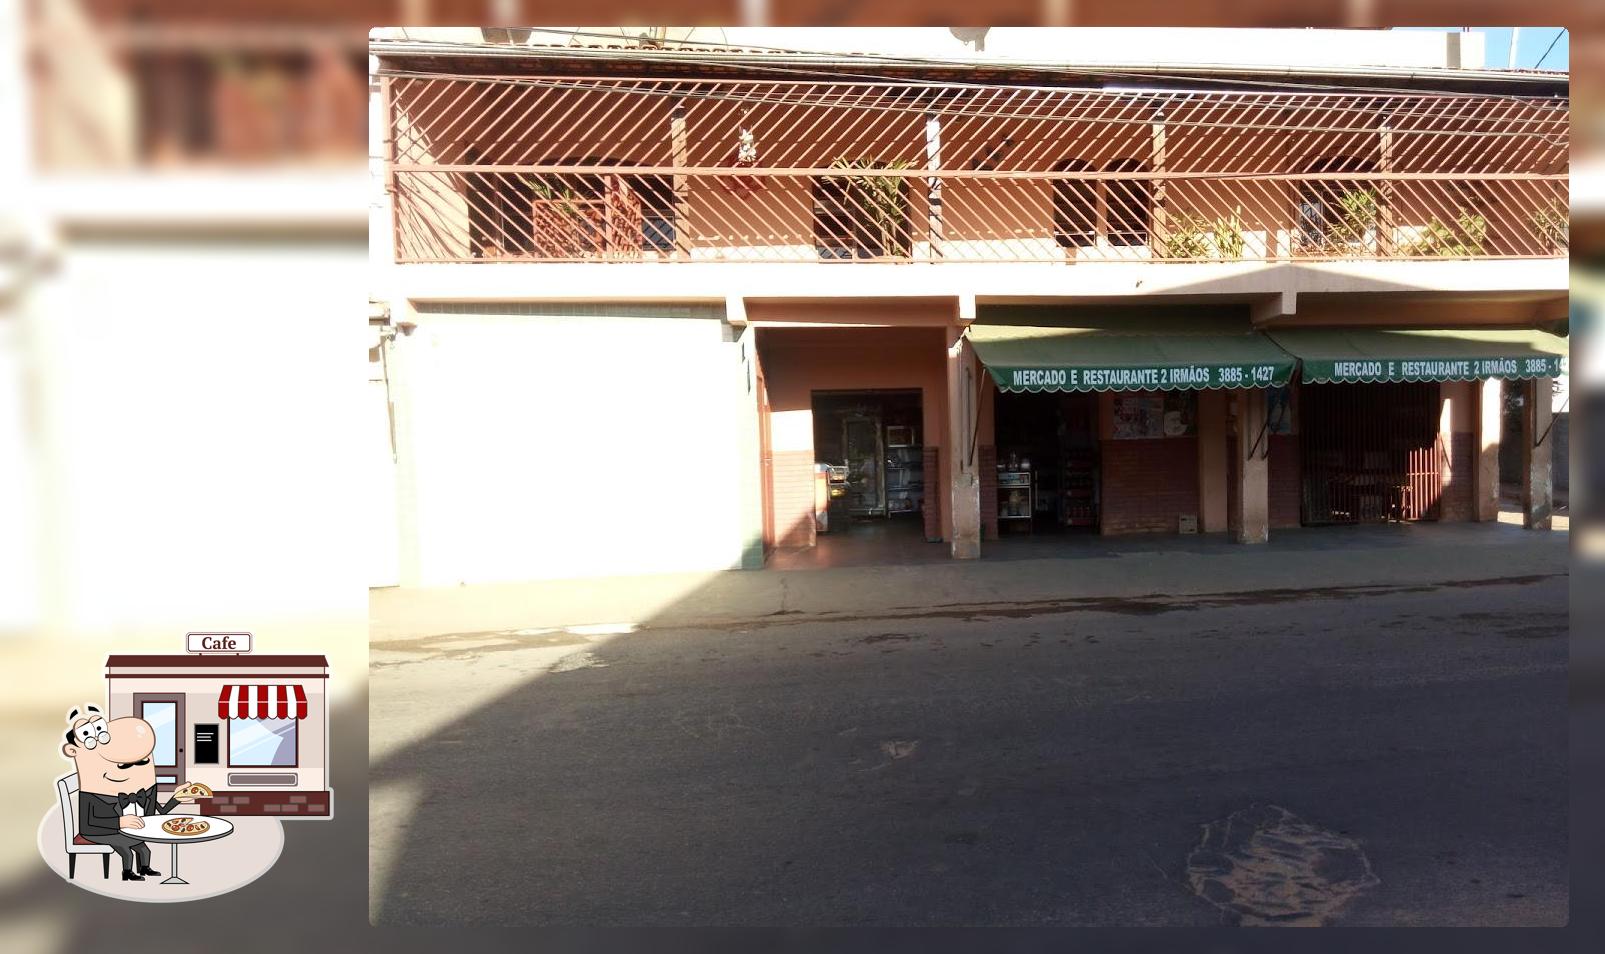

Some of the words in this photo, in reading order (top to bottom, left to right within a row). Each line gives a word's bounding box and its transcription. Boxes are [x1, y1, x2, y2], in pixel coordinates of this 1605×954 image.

[1013, 370, 1066, 385] MERCADO
[1070, 369, 1078, 384] E
[1083, 369, 1158, 384] RESTAURANTE
[1160, 369, 1168, 383] 2
[1169, 366, 1209, 383] IRMÃOS
[1218, 367, 1242, 382] 3885
[1250, 366, 1274, 381] 1427
[1334, 362, 1382, 376] MERCADO
[1388, 362, 1395, 375] E
[1401, 361, 1469, 375] RESTAURANTE
[1473, 361, 1480, 374] 2
[1481, 358, 1517, 374] IRMÃOS
[1525, 359, 1546, 373] 3885
